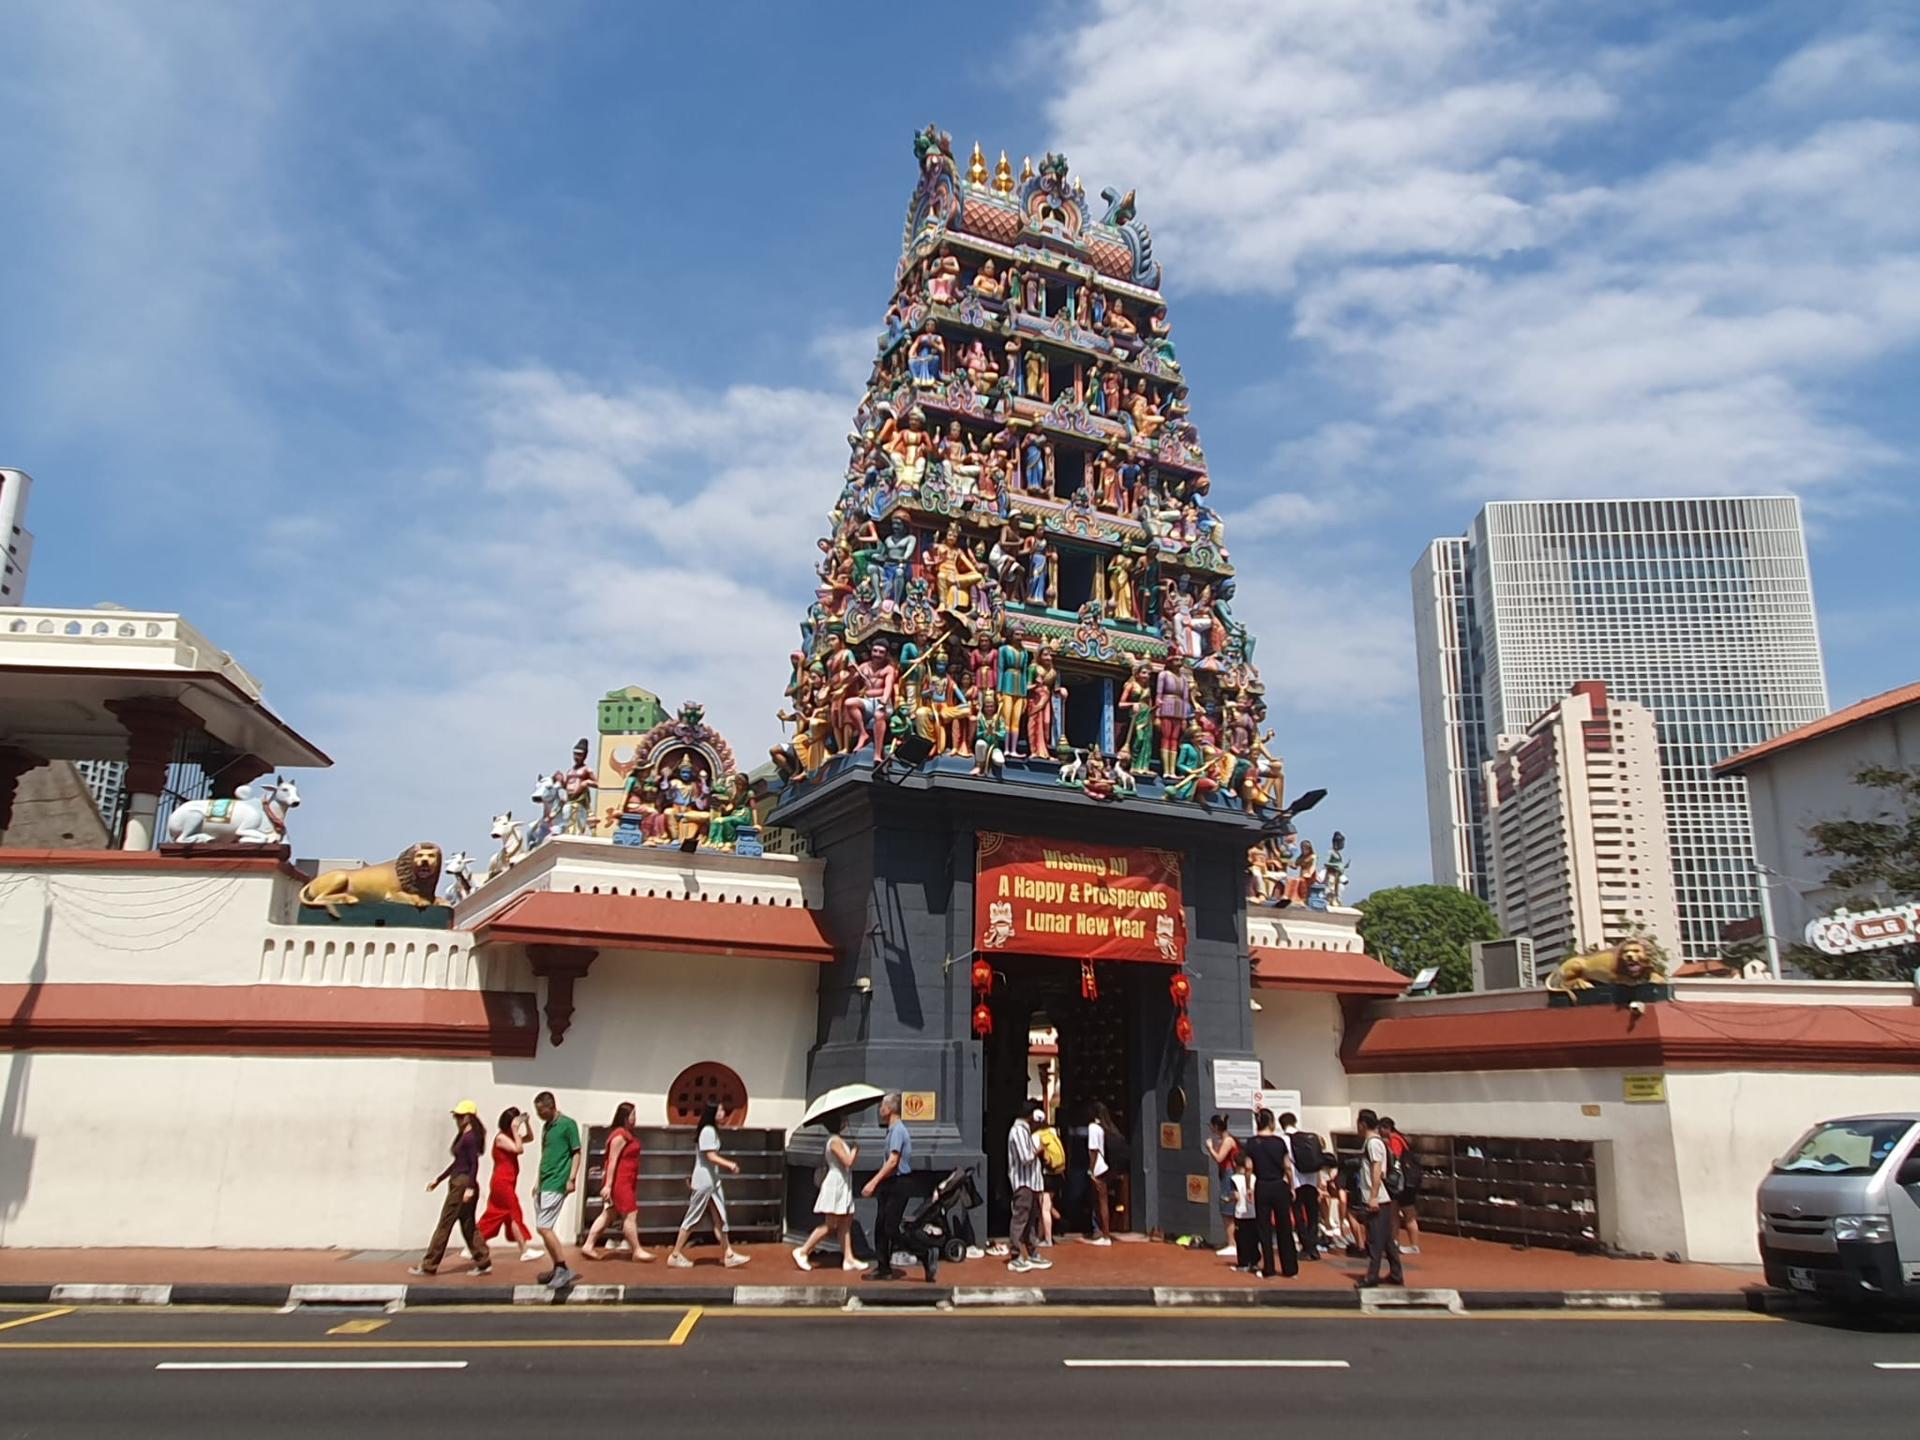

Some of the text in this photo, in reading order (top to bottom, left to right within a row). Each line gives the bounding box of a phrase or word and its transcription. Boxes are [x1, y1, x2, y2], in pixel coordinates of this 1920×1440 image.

[1043, 849, 1128, 876] Wishing All
[998, 875, 1167, 910] A Happy & Prosperous
[1026, 908, 1146, 939] Lunar New Year
